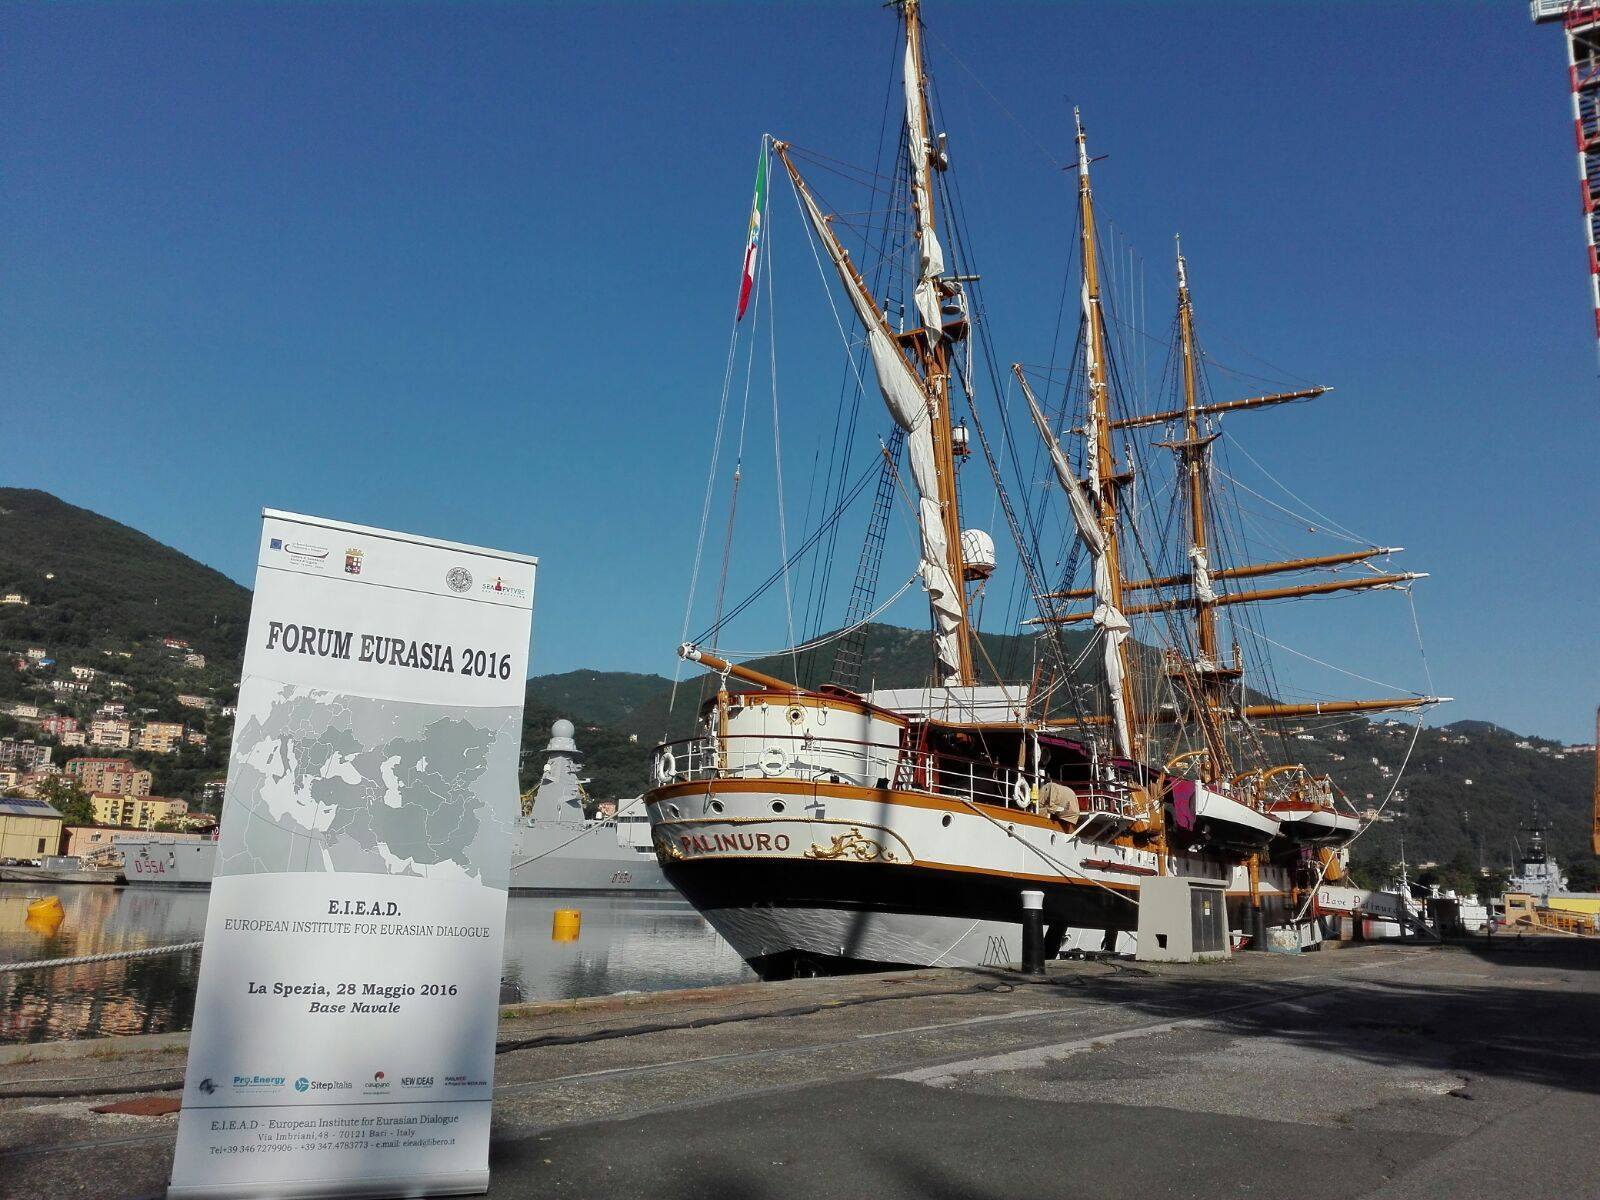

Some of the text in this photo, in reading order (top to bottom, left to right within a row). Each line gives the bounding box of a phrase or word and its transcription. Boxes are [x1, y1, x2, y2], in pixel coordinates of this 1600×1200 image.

[266, 621, 512, 680] FORUM EURASIA 2016
[680, 833, 790, 853] PALINURO
[328, 900, 401, 916] E.I.E.A.D.
[225, 919, 490, 938] EUROPEAN INSTITUTE FOR EURASIAN DIALOGUE
[248, 982, 457, 999] La Spezia, 28 Maggio 2016
[309, 1002, 401, 1014] Base Navale
[269, 1120, 316, 1130] European
[319, 1117, 359, 1127] Institute
[361, 1116, 374, 1126] for
[376, 1115, 417, 1126] Eurasian
[420, 1114, 459, 1125] Dialogue
[369, 1129, 387, 1137] Bari
[396, 1129, 416, 1137] Italy
